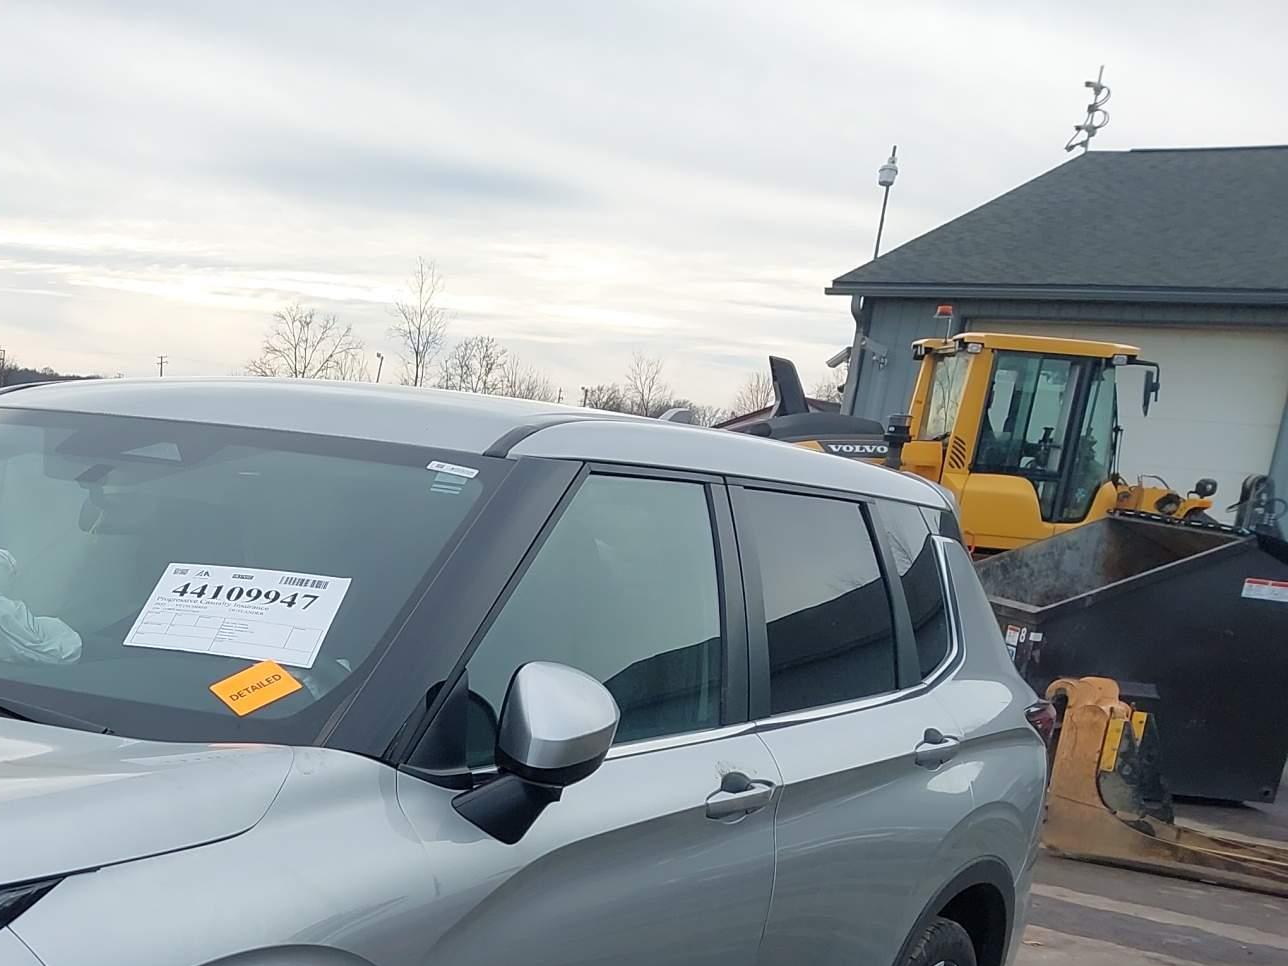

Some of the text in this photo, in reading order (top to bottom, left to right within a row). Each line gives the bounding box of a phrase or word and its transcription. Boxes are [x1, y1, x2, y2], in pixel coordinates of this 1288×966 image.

[827, 444, 889, 454] VOLVO
[172, 582, 320, 610] 44109947
[1019, 627, 1027, 643] 8
[229, 673, 282, 702] DETAILED
